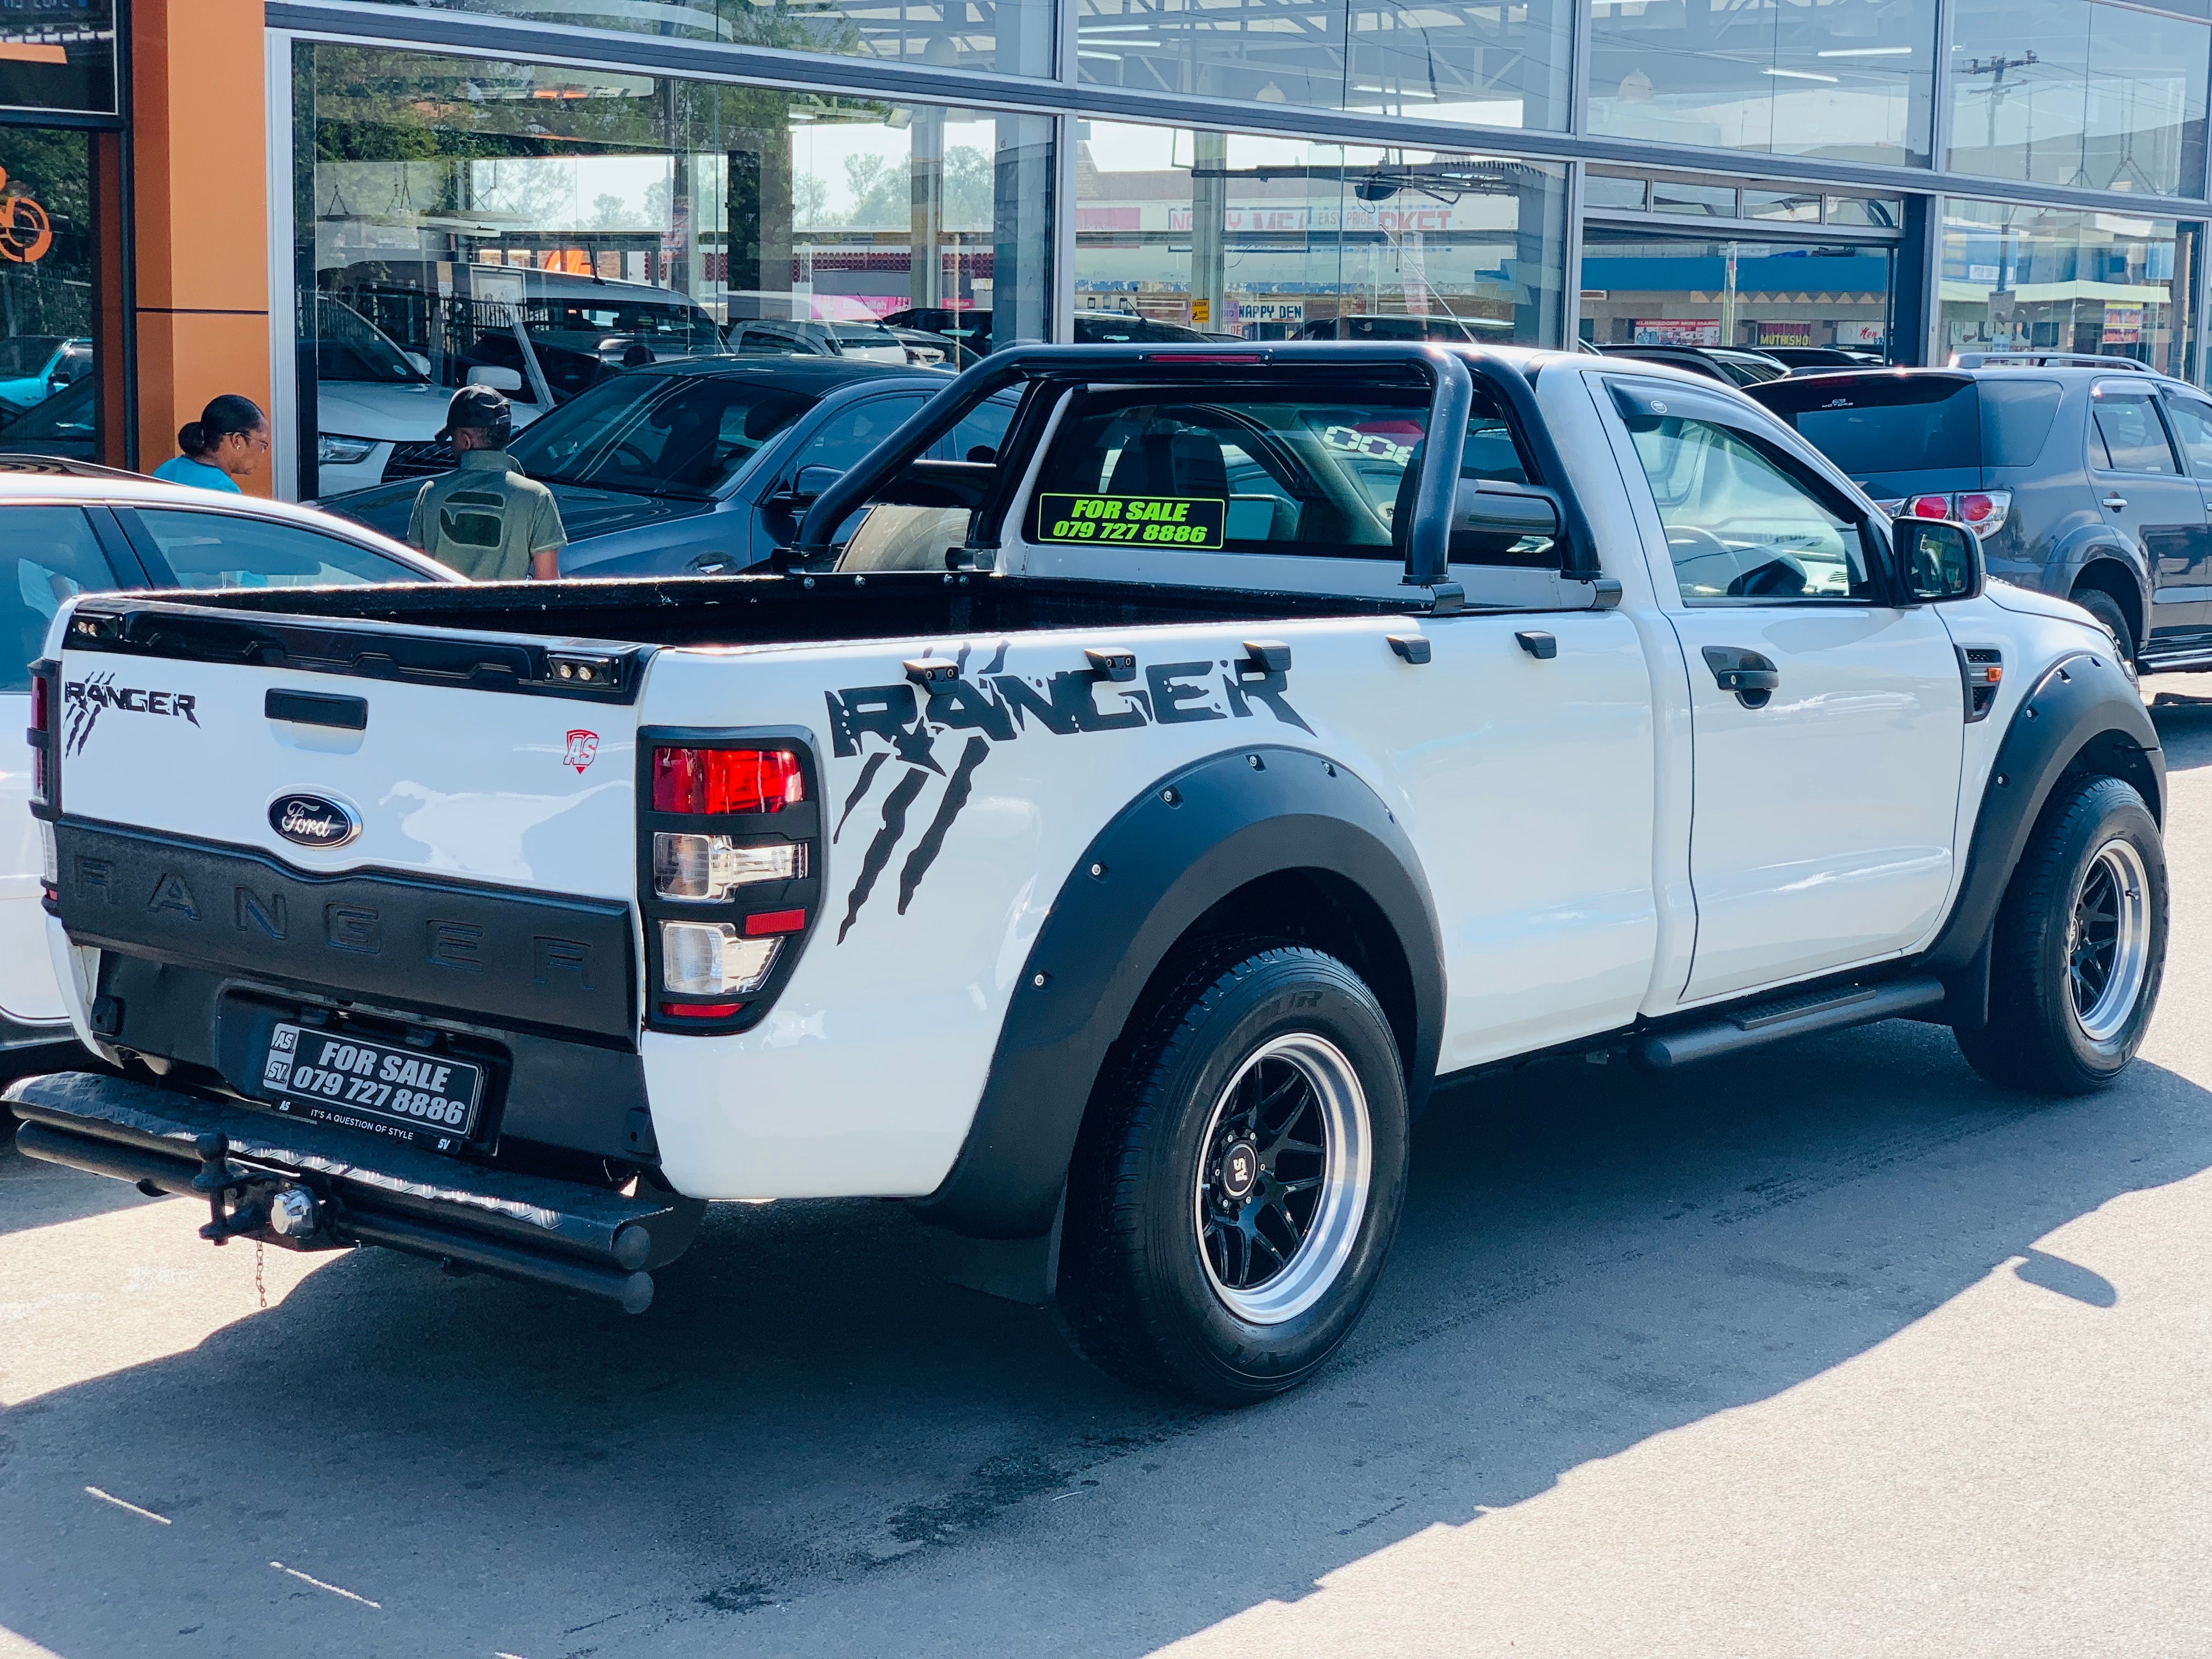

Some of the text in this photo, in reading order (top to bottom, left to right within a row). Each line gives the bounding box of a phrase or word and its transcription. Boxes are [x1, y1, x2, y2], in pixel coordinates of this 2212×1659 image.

[1318, 211, 1374, 225] EASY PRICE
[1239, 304, 1274, 318] NAPPY
[1279, 305, 1302, 319] DEN
[1071, 499, 1190, 522] FOR SALE
[1052, 521, 1208, 544] 079 727 8886
[64, 680, 201, 730] RANGER
[824, 657, 1318, 777] RANGER
[563, 735, 599, 766] AS
[281, 800, 332, 838] Ford
[73, 853, 597, 991] RANGER
[274, 1031, 295, 1050] AS
[318, 1041, 452, 1093] FOR SALE
[293, 1065, 466, 1125] 079 727 8886
[310, 1109, 325, 1119] IT'S
[333, 1114, 374, 1131] QUESTION
[375, 1124, 387, 1133] OF
[388, 1127, 414, 1141] STYLE
